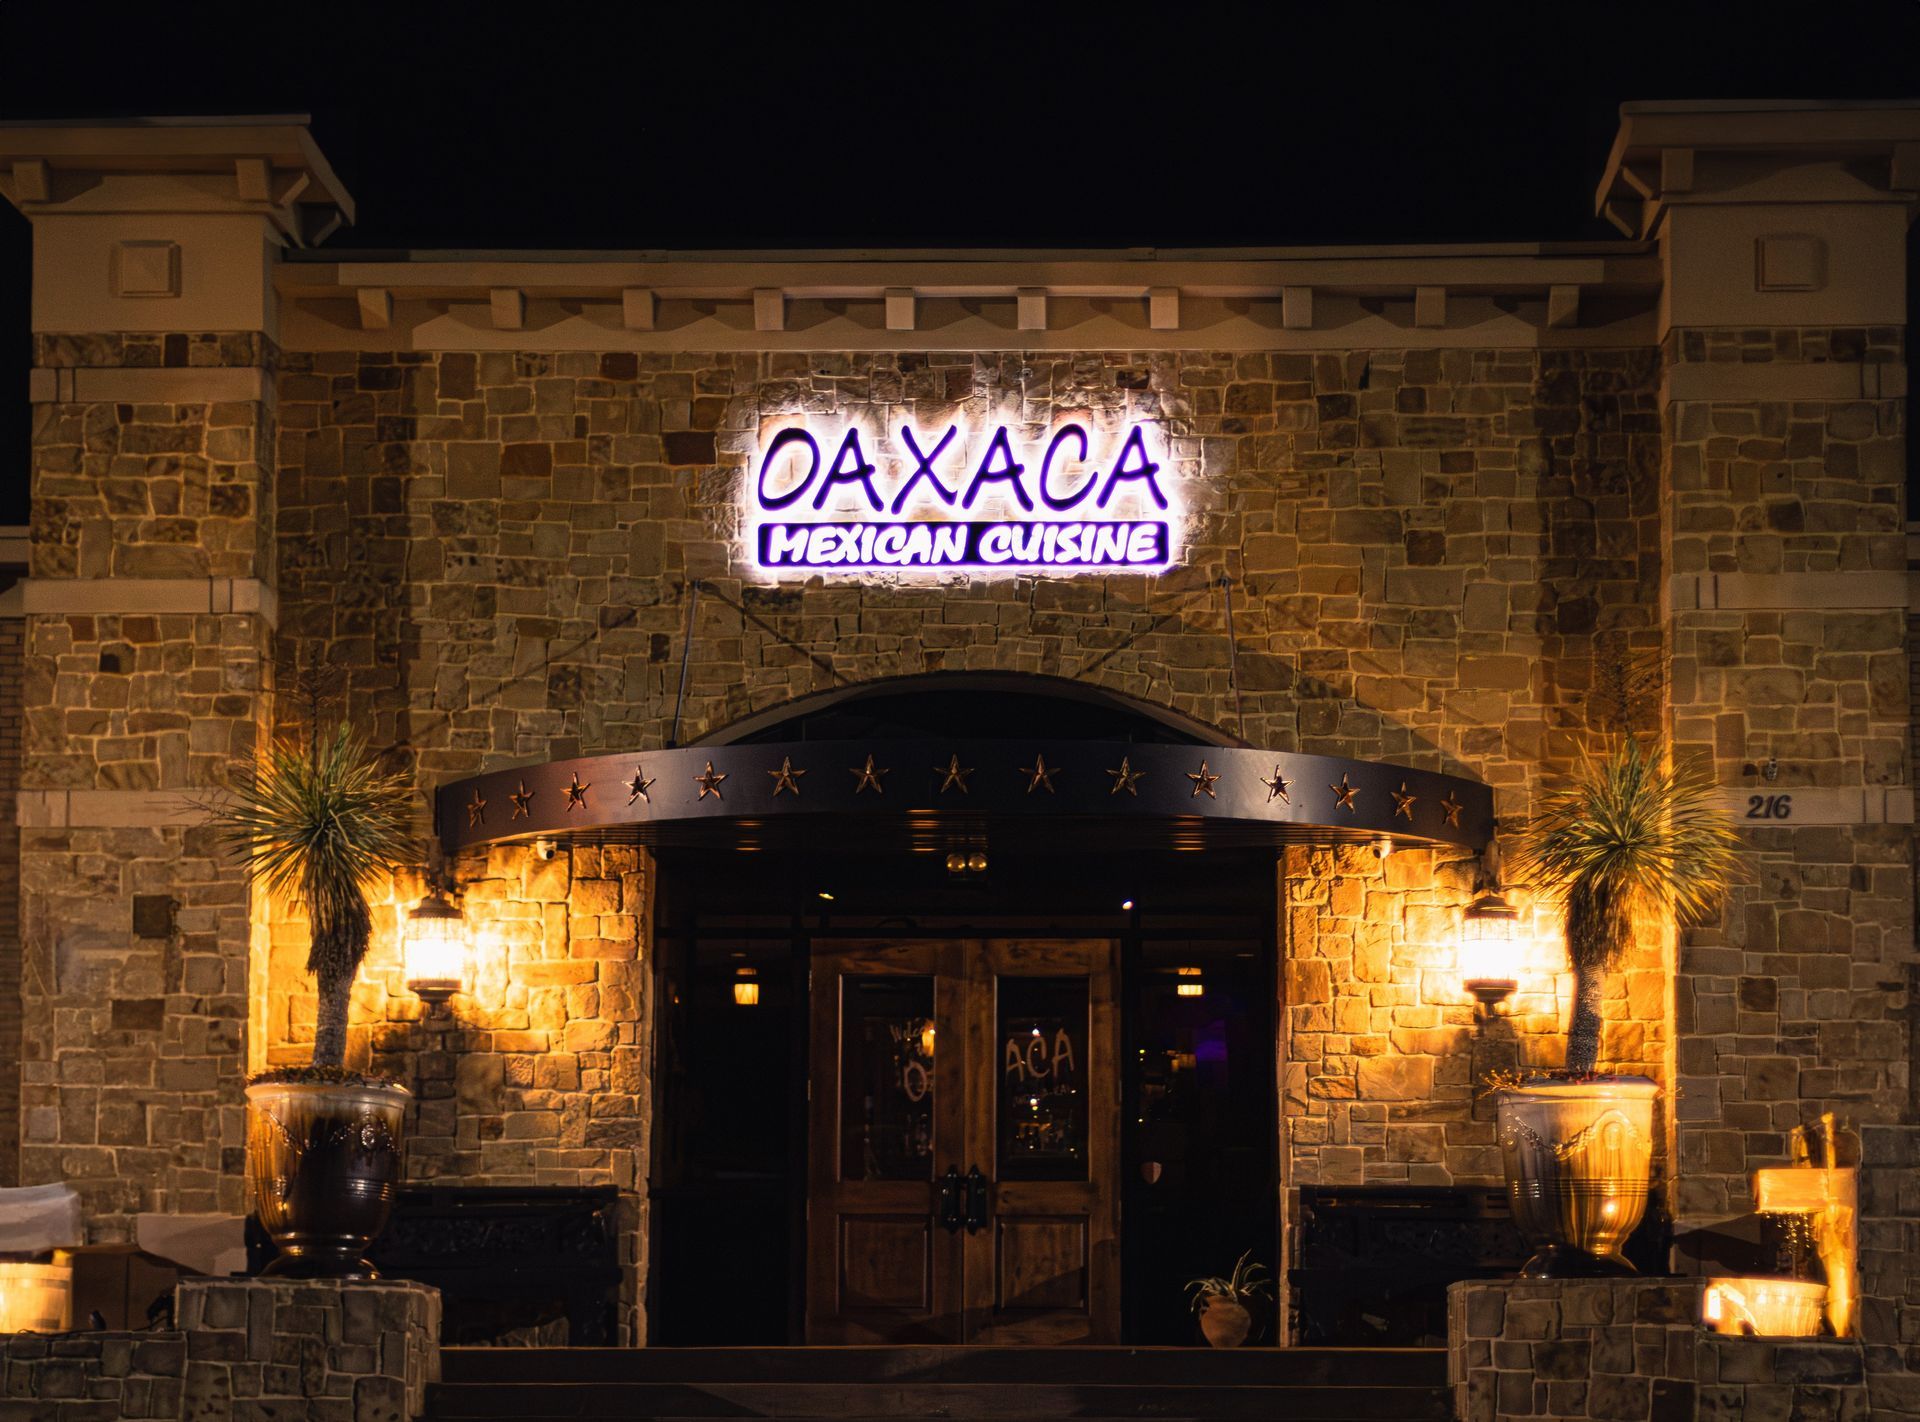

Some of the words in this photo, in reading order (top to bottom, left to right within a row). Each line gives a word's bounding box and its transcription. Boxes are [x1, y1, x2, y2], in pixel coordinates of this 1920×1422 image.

[757, 423, 1169, 515] OAXACA
[768, 523, 969, 565] MEXICAN
[978, 523, 1159, 565] CUISINE
[1746, 794, 1792, 819] 216
